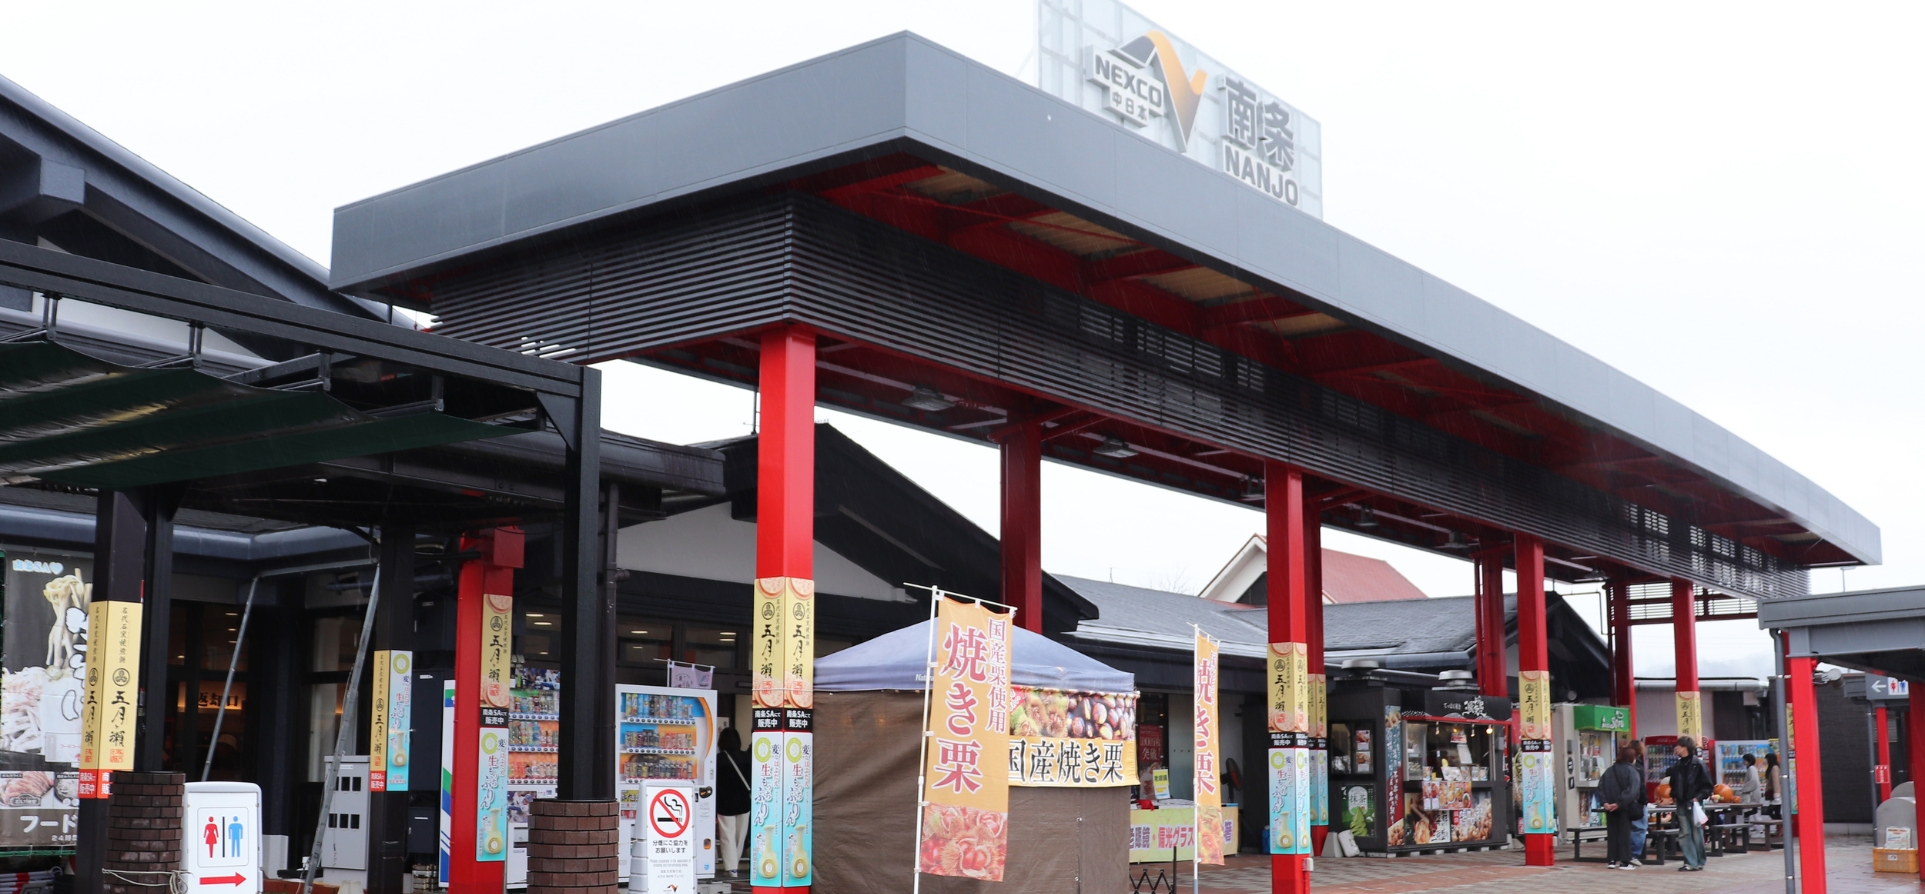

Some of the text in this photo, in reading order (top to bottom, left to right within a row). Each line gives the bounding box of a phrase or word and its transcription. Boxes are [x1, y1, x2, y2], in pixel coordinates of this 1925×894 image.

[1095, 54, 1163, 108] NEXCO
[1112, 90, 1148, 121] 中日本
[1225, 76, 1295, 171] 南条
[1224, 146, 1298, 206] NANJO
[986, 617, 1007, 733] 国産栗使用
[485, 717, 504, 725] 販売中
[755, 710, 781, 718] 南条SAにて
[757, 719, 778, 728] 販売中
[787, 710, 811, 718] 南条SAにて
[789, 719, 808, 728] 販売中
[932, 622, 988, 795] 焼き栗
[1009, 740, 1123, 783] 国産焼き栗
